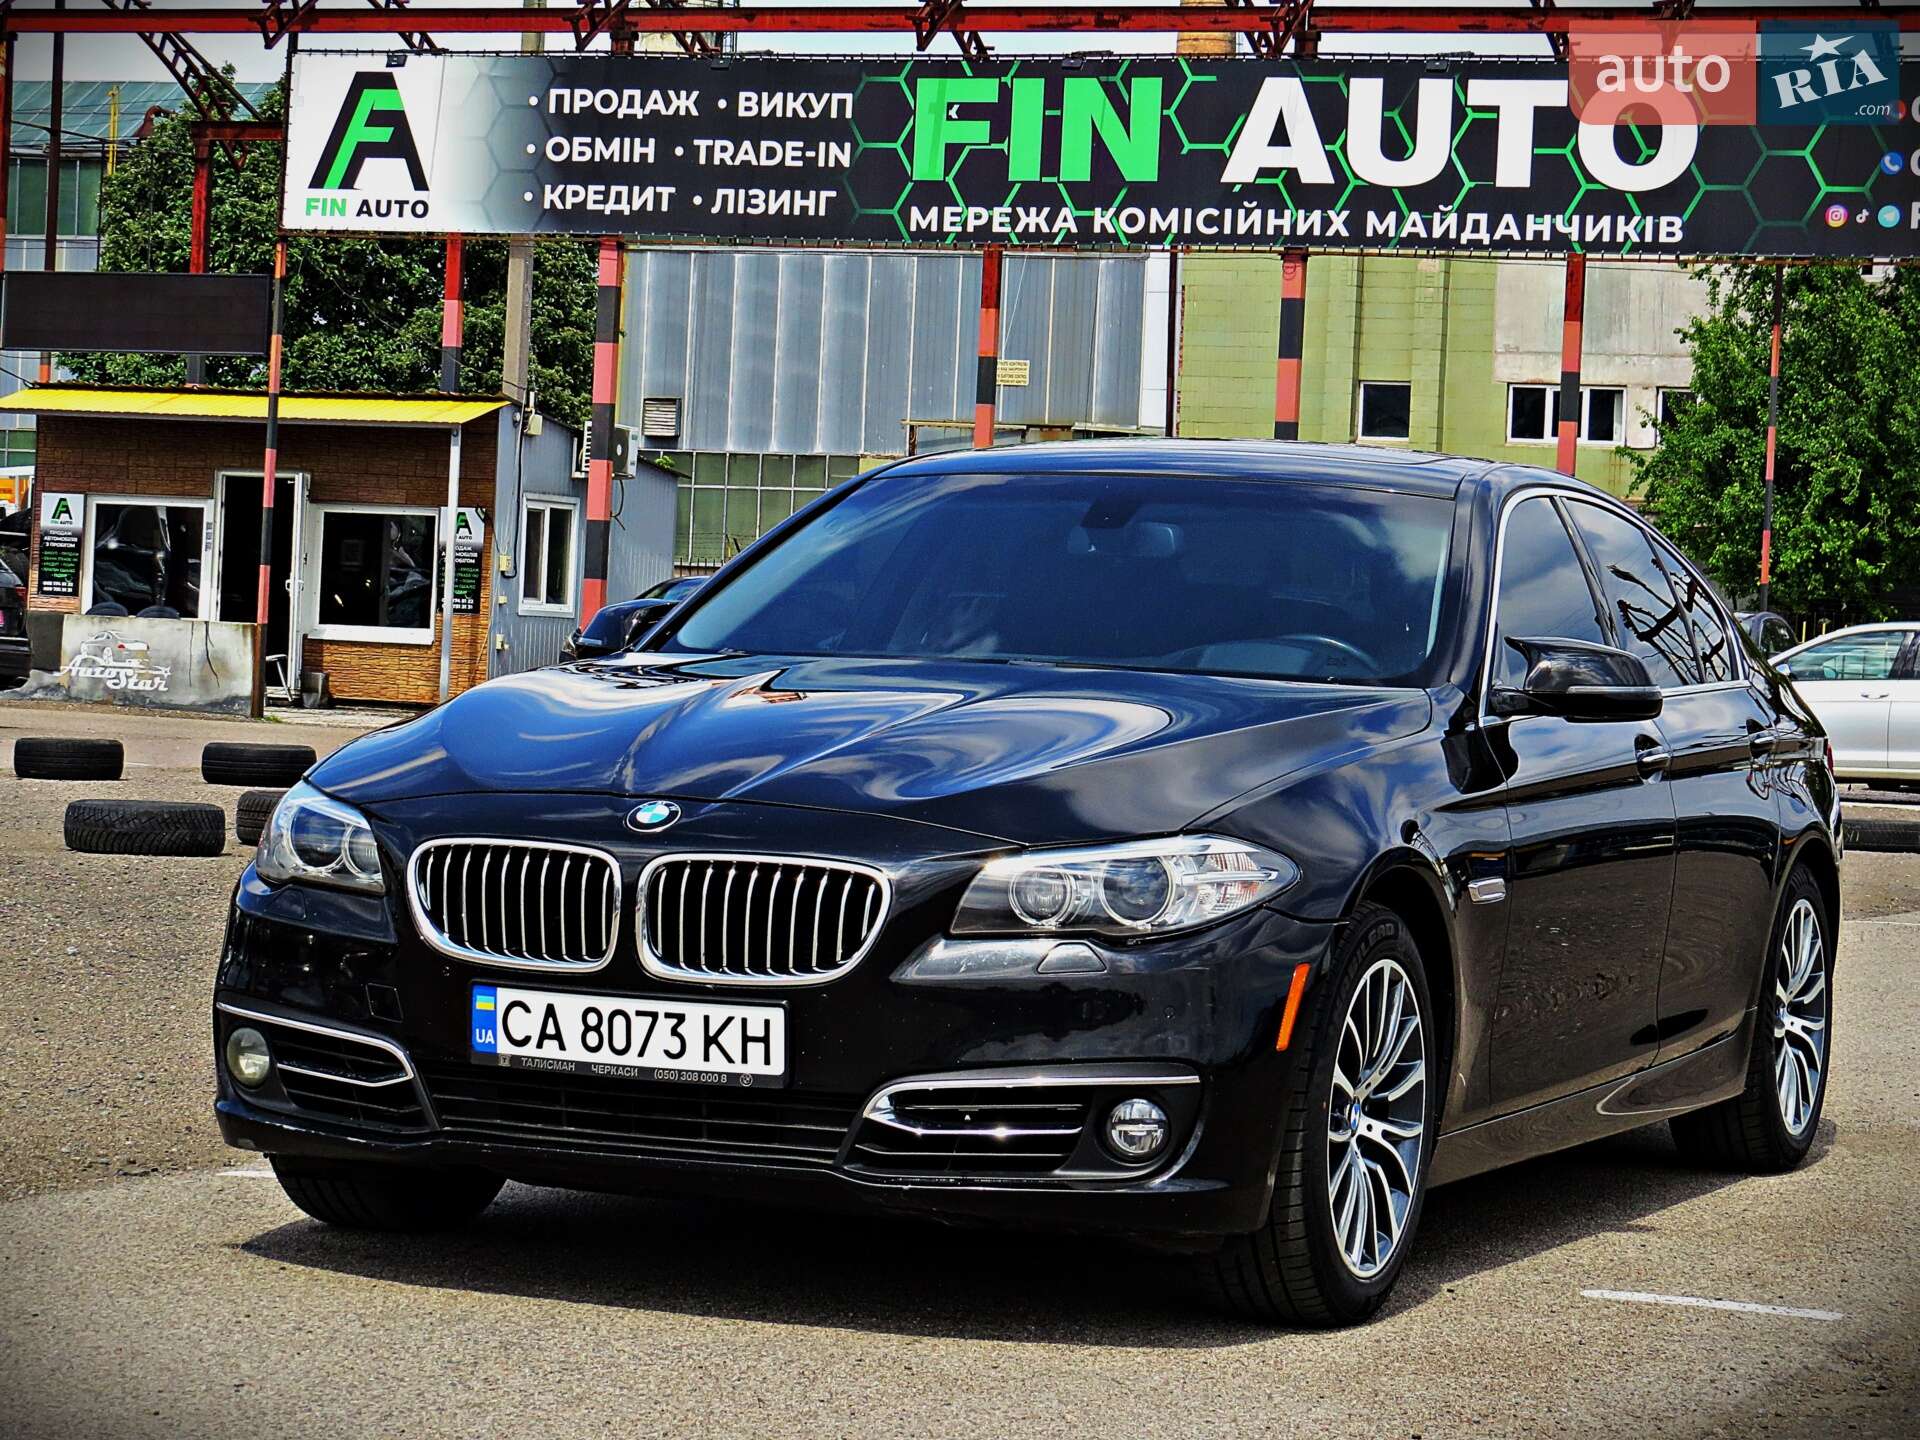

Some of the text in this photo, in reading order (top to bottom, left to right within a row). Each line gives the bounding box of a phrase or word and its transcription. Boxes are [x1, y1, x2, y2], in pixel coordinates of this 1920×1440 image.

[548, 89, 854, 119] ПРОДАЖ ВИКУП
[912, 77, 1699, 192] FIN AUTO
[545, 136, 852, 168] ОБМІН TRADE-IN
[305, 198, 429, 219] FIN AUTO
[543, 184, 837, 217] КРЕДИТ ЛІЗИНГ
[909, 201, 1684, 245] МЕРЕЖА КОМІСІЙНИХ МАЙДАНЧИКІВ
[475, 1029, 496, 1045] UA
[502, 1000, 771, 1066] CA 8073 KH
[521, 1057, 576, 1072] ТАЛИСМАН
[591, 1064, 638, 1078] ЧЕРКАСИ
[654, 1069, 679, 1082] (050)
[680, 1071, 699, 1082] 308
[700, 1073, 719, 1083] 000
